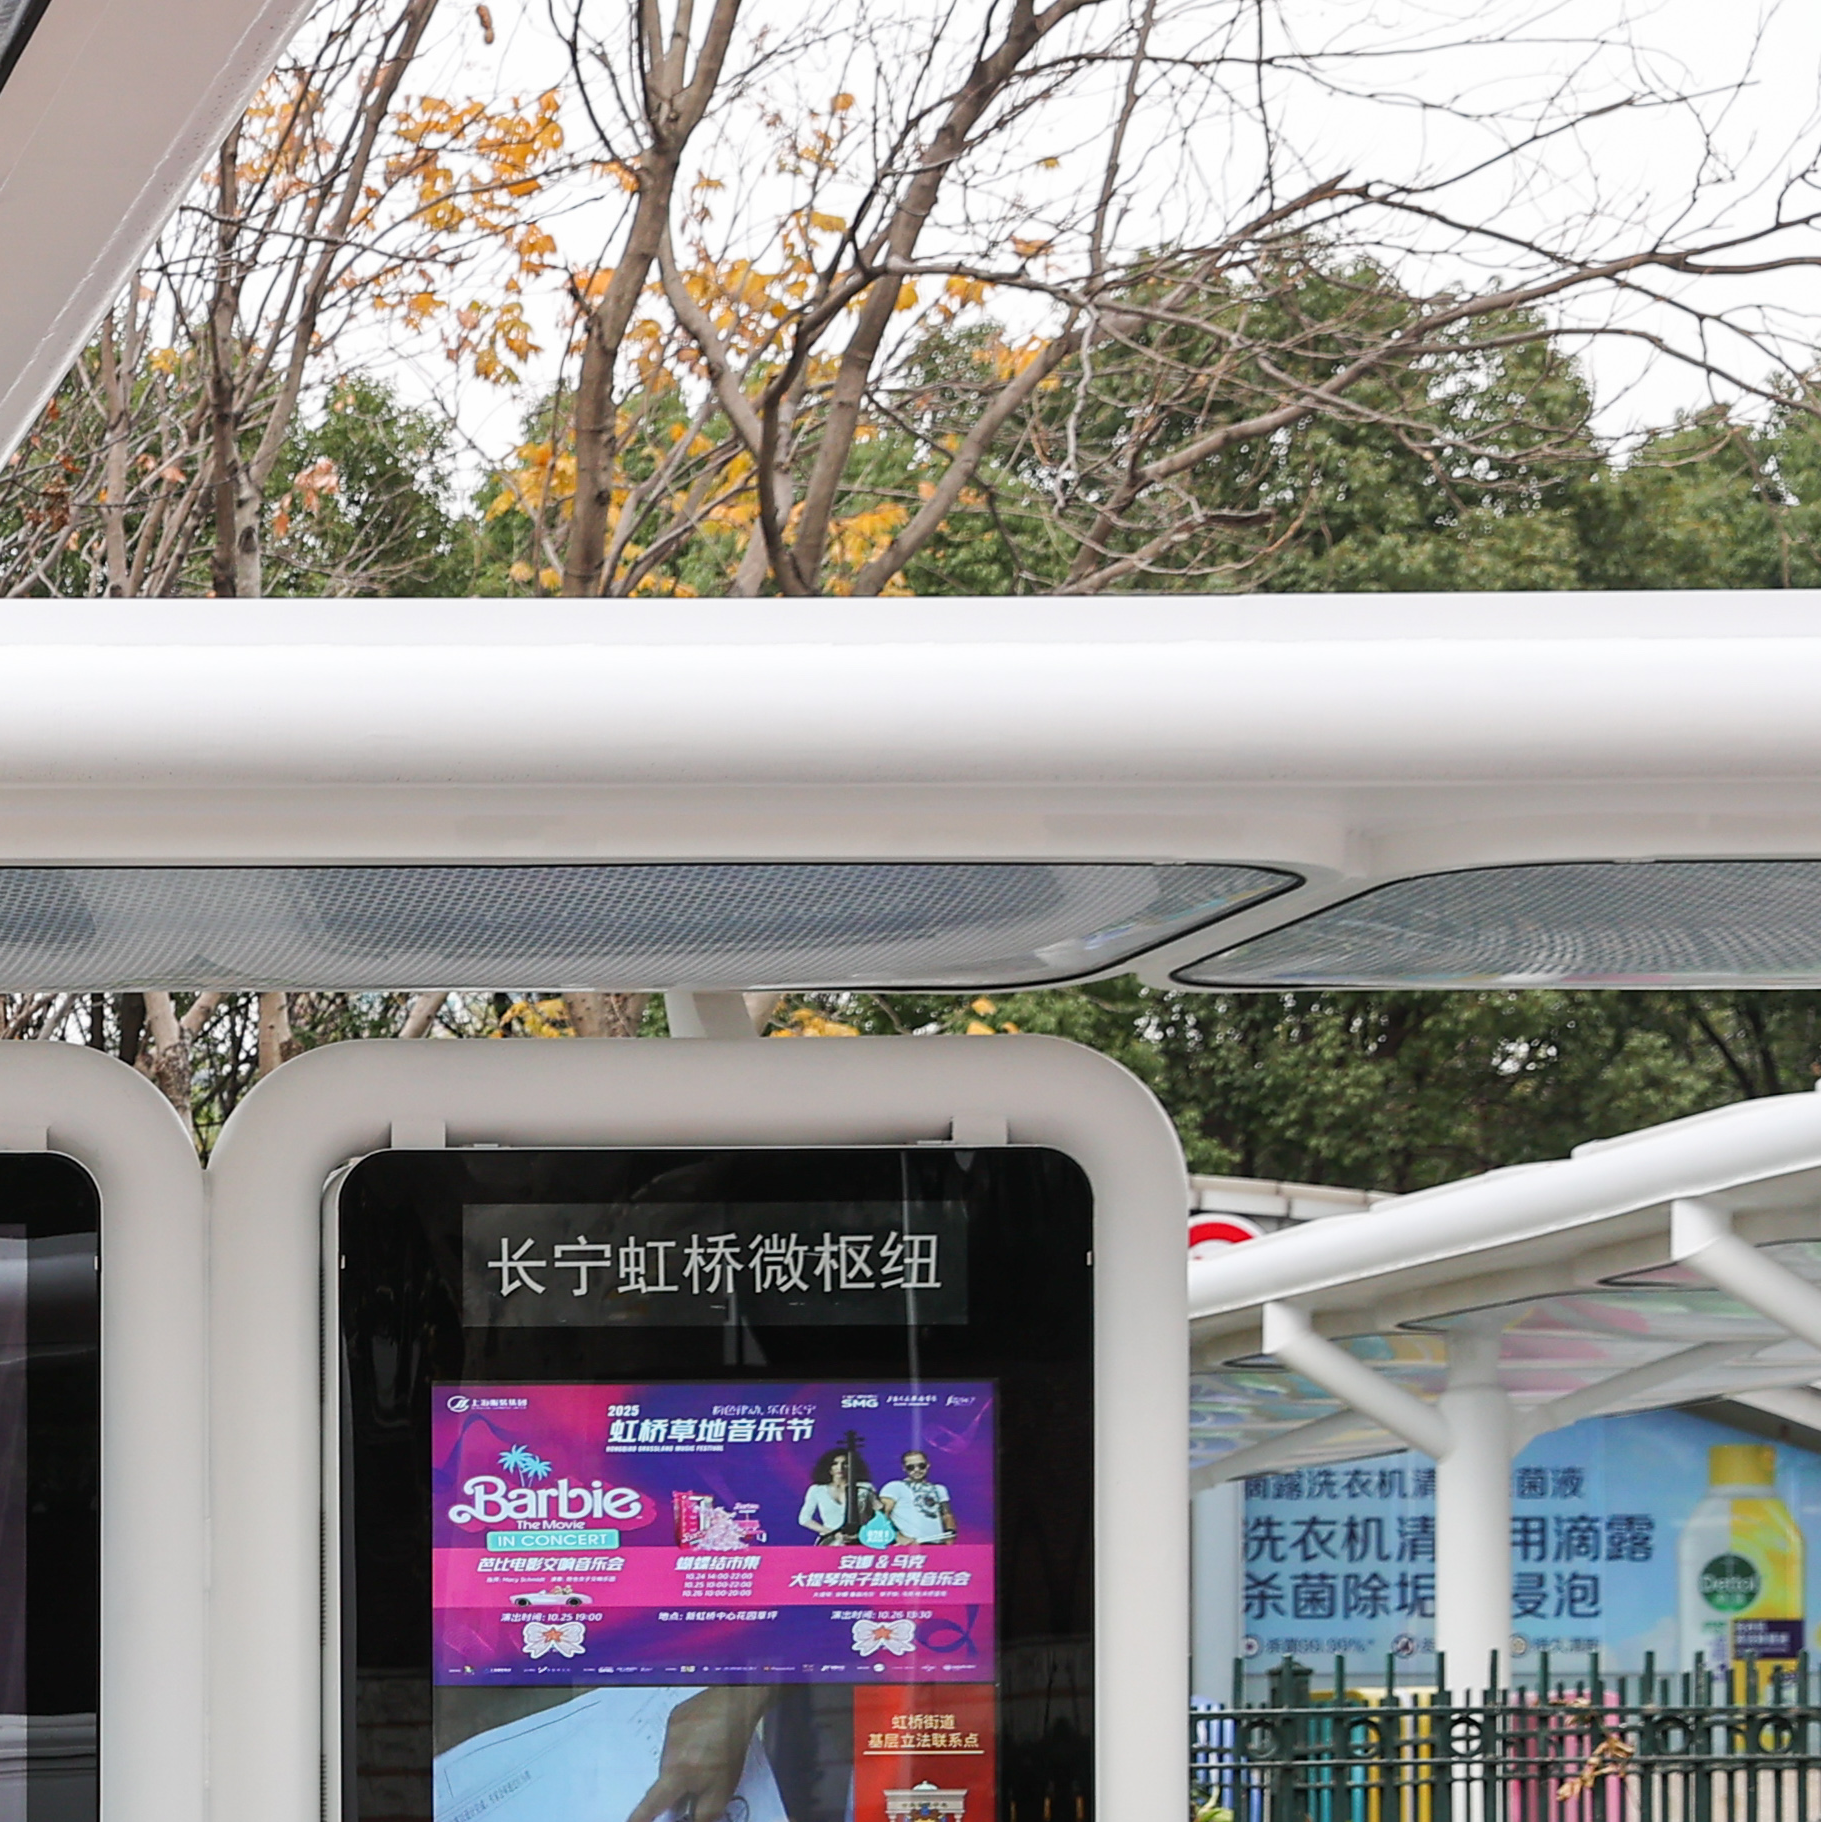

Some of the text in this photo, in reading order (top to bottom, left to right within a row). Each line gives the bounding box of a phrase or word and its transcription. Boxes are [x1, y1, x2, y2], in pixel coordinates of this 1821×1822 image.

[487, 1231, 942, 1297] 长宁虹桥微枢纽
[607, 1405, 640, 1416] 2025
[841, 1399, 879, 1408] SMG
[607, 1418, 815, 1443] 虹桥草地音乐节
[448, 1475, 643, 1524] Barbie
[516, 1520, 586, 1530] The Movie
[497, 1533, 608, 1547] IN CONCERT
[476, 1556, 626, 1573] 芭比电影交响音乐会
[788, 1571, 972, 1588] 大提琴架子鼓跨界音乐会
[547, 1613, 575, 1622] 10.25
[575, 1613, 604, 1622] 19:00
[891, 1714, 956, 1730] 虹桥街道
[868, 1732, 980, 1749] 基层立法联系点
